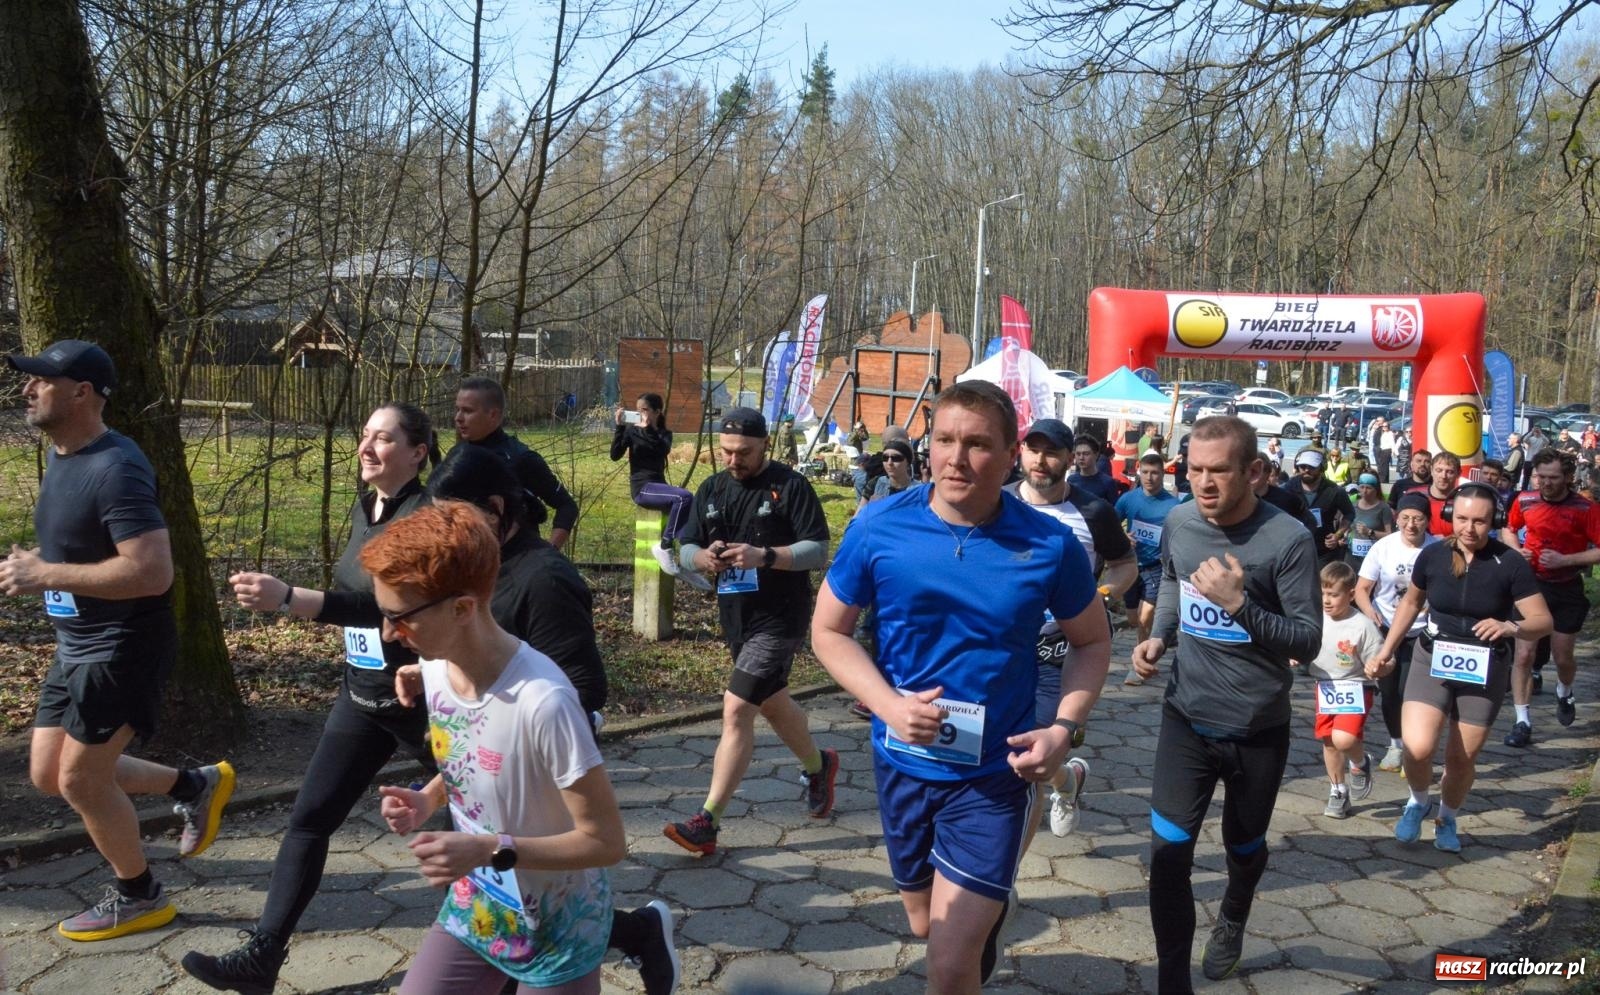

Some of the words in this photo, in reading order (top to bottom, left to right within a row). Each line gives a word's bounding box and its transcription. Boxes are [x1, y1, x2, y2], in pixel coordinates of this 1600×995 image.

[1275, 302, 1317, 313] BIEG
[1239, 318, 1356, 334] TWARDZIELA
[1249, 337, 1343, 351] RACIBÓRZ
[1137, 529, 1154, 540] 105
[1190, 602, 1234, 628] 009
[349, 632, 368, 653] 118
[1441, 654, 1478, 672] 020
[1325, 692, 1355, 705] 065
